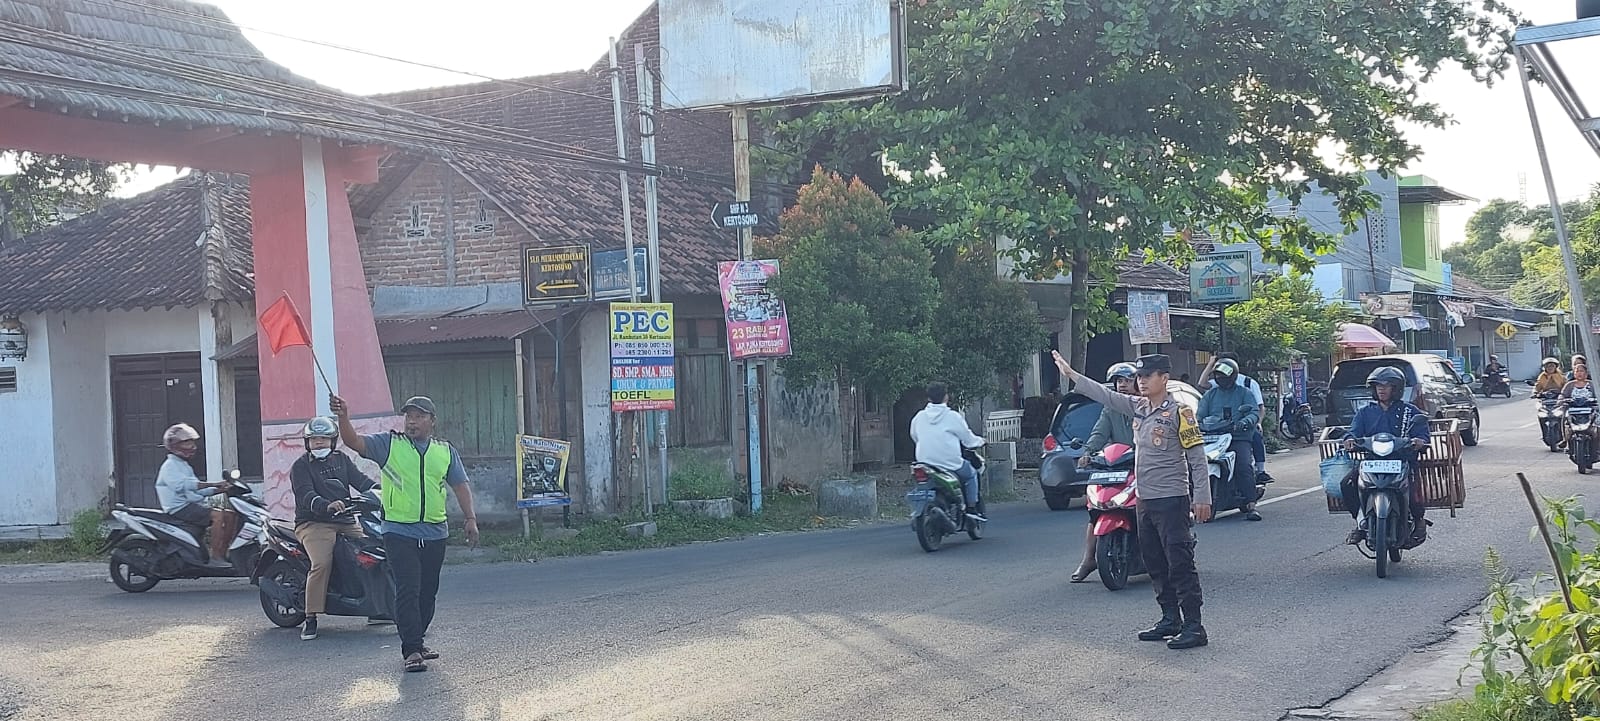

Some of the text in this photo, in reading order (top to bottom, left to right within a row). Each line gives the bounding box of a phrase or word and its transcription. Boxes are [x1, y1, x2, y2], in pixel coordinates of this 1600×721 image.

[723, 214, 758, 226] KERTOSONO
[613, 311, 669, 333] PEC
[732, 328, 744, 339] 23
[613, 391, 651, 400] TOEFL
